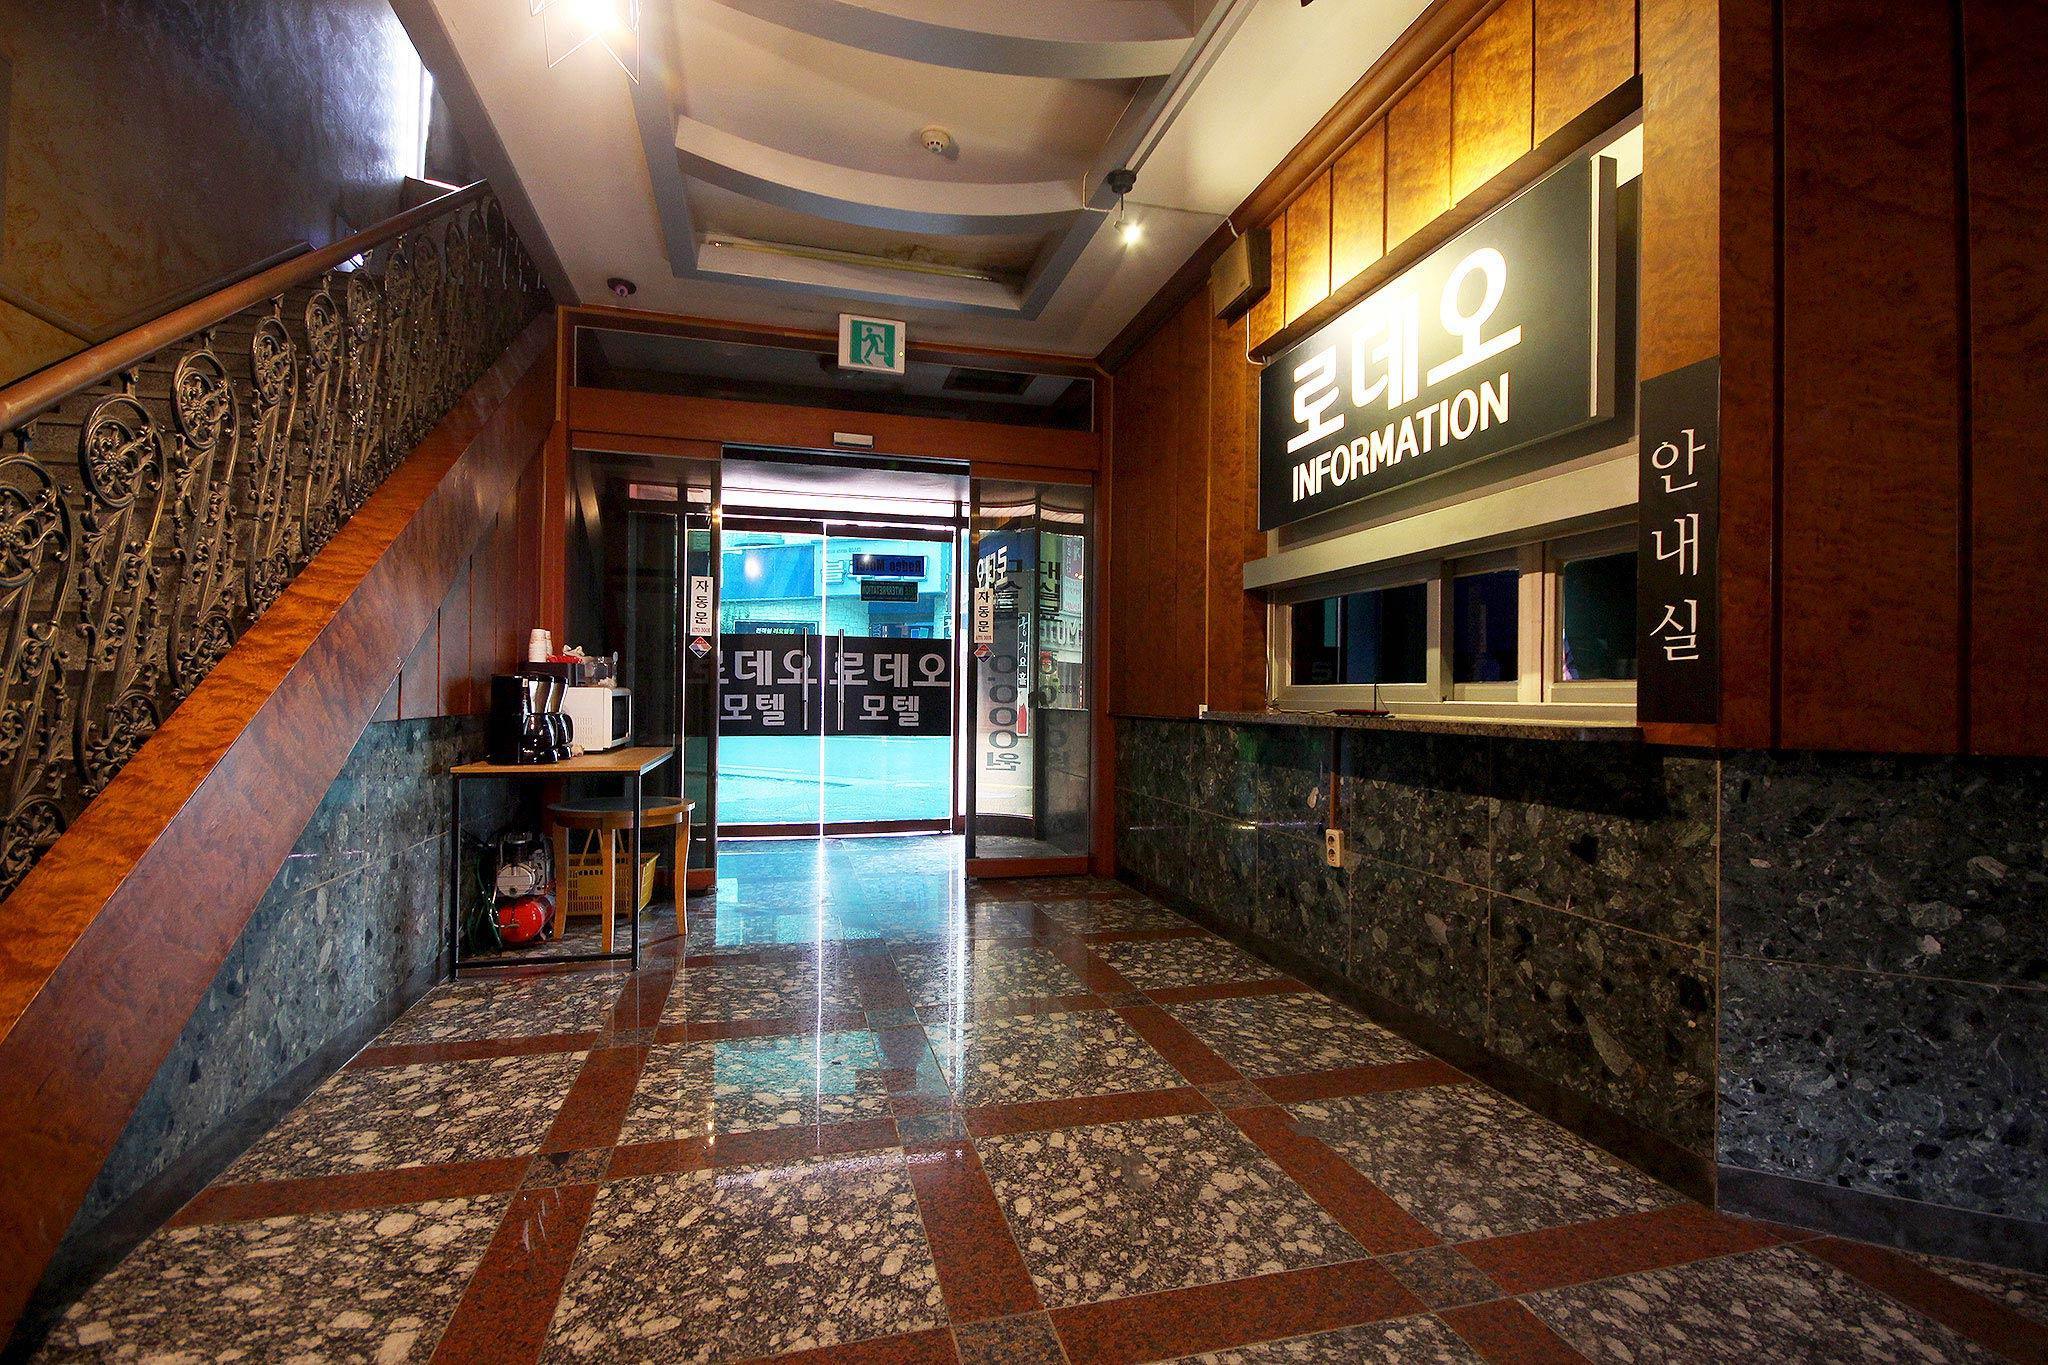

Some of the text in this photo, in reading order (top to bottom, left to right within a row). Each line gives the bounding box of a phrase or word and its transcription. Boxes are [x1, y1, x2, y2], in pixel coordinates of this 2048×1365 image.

[1287, 247, 1523, 455] 로데오
[1291, 371, 1511, 503] INFORMATION
[1649, 428, 1706, 662] 안내실
[695, 580, 709, 625] 자동문
[977, 591, 991, 634] 자동문
[829, 651, 951, 689] 로데오
[719, 693, 786, 727] 모텔
[858, 694, 920, 727] 모텔
